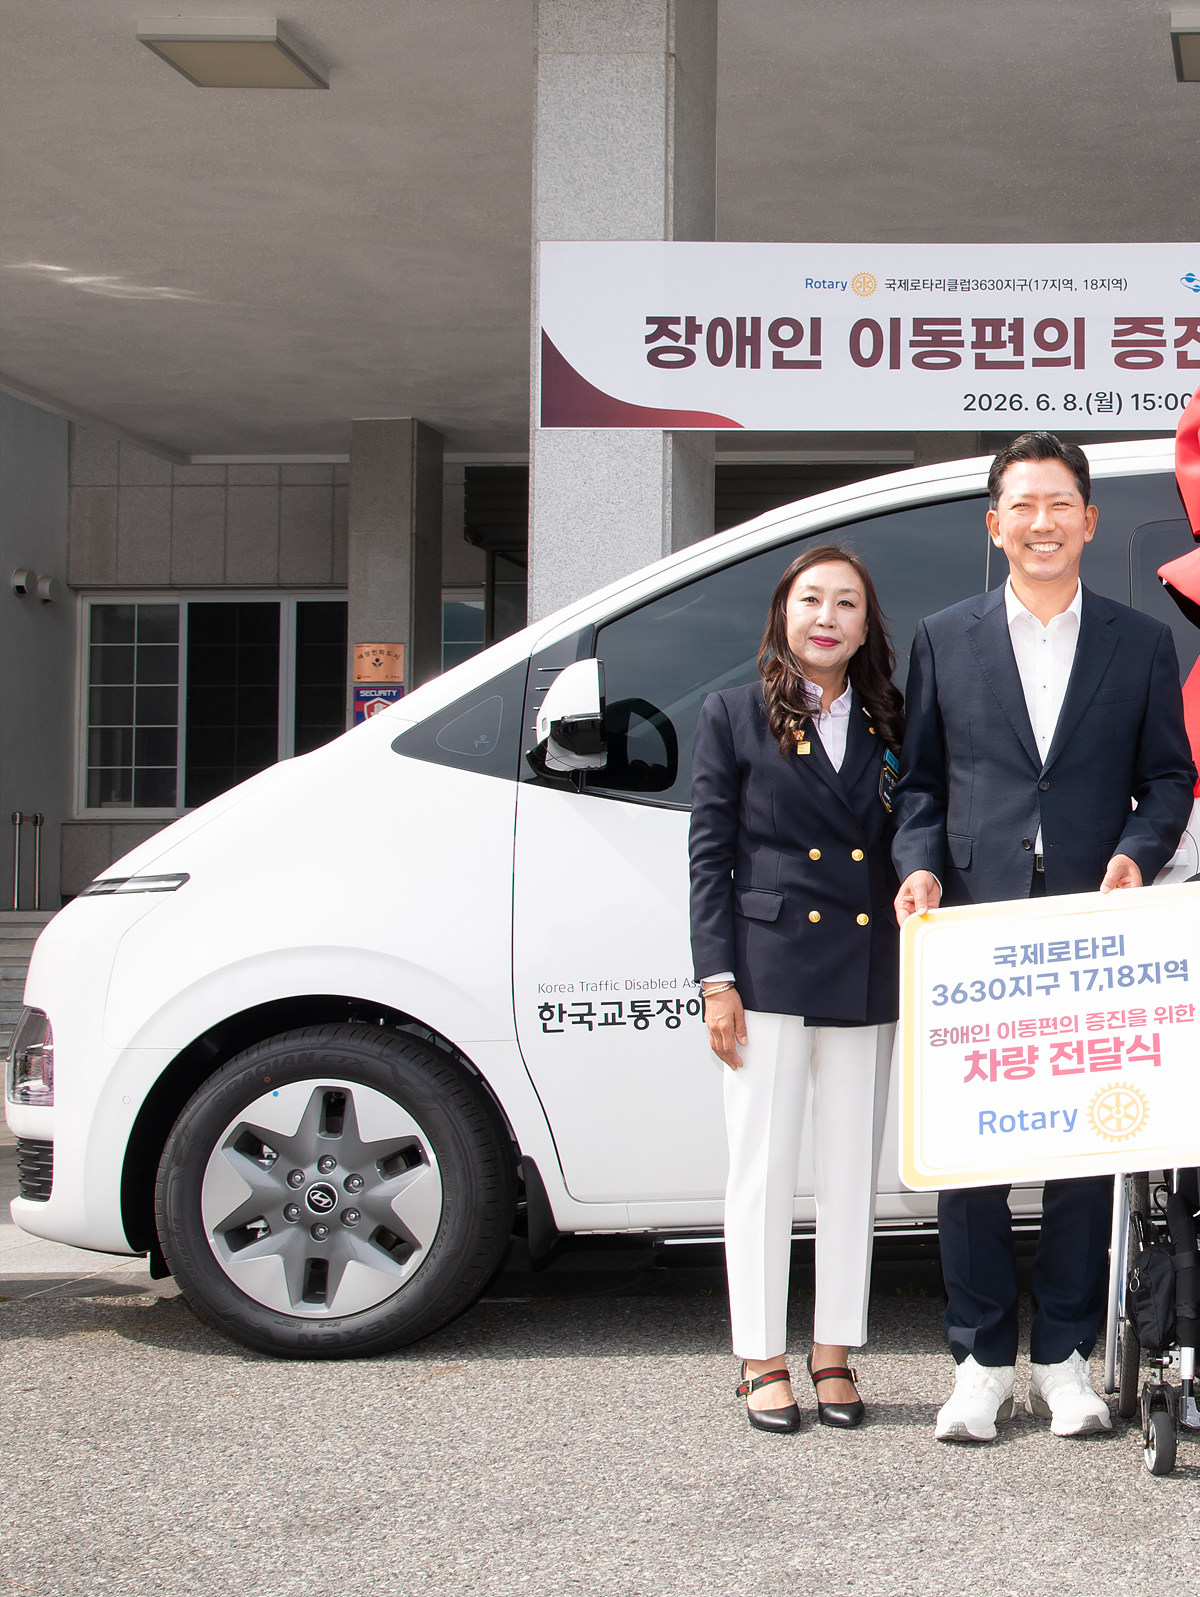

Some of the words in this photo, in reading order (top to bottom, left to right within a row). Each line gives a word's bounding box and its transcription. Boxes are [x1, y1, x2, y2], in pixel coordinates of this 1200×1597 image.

[806, 278, 848, 291] Rotary
[884, 278, 1077, 292] 국제로타리클럽3630지구(17지역,
[1083, 278, 1128, 292] 18지역)
[644, 315, 822, 371] 장애인
[848, 316, 1086, 371] 이동편의
[963, 393, 1029, 412] 2026.
[1036, 393, 1056, 412] 6.
[1063, 391, 1123, 416] 8.(월)
[360, 689, 397, 697] SECURITY
[993, 934, 1126, 969] 국제로타리
[537, 983, 575, 994] Korea
[579, 979, 620, 992] Traffic
[624, 977, 677, 991] Disabled
[931, 972, 1061, 1007] 3630지구
[1069, 958, 1190, 993] 17,18지역
[929, 1023, 991, 1048] 장애인
[997, 1014, 1079, 1041] 이동편의
[1085, 1007, 1148, 1032] 증진을
[1153, 1003, 1196, 1026] 위한
[963, 1045, 1040, 1084] 차량
[1050, 1032, 1162, 1077] 전달식
[978, 1108, 1078, 1135] Rotary
